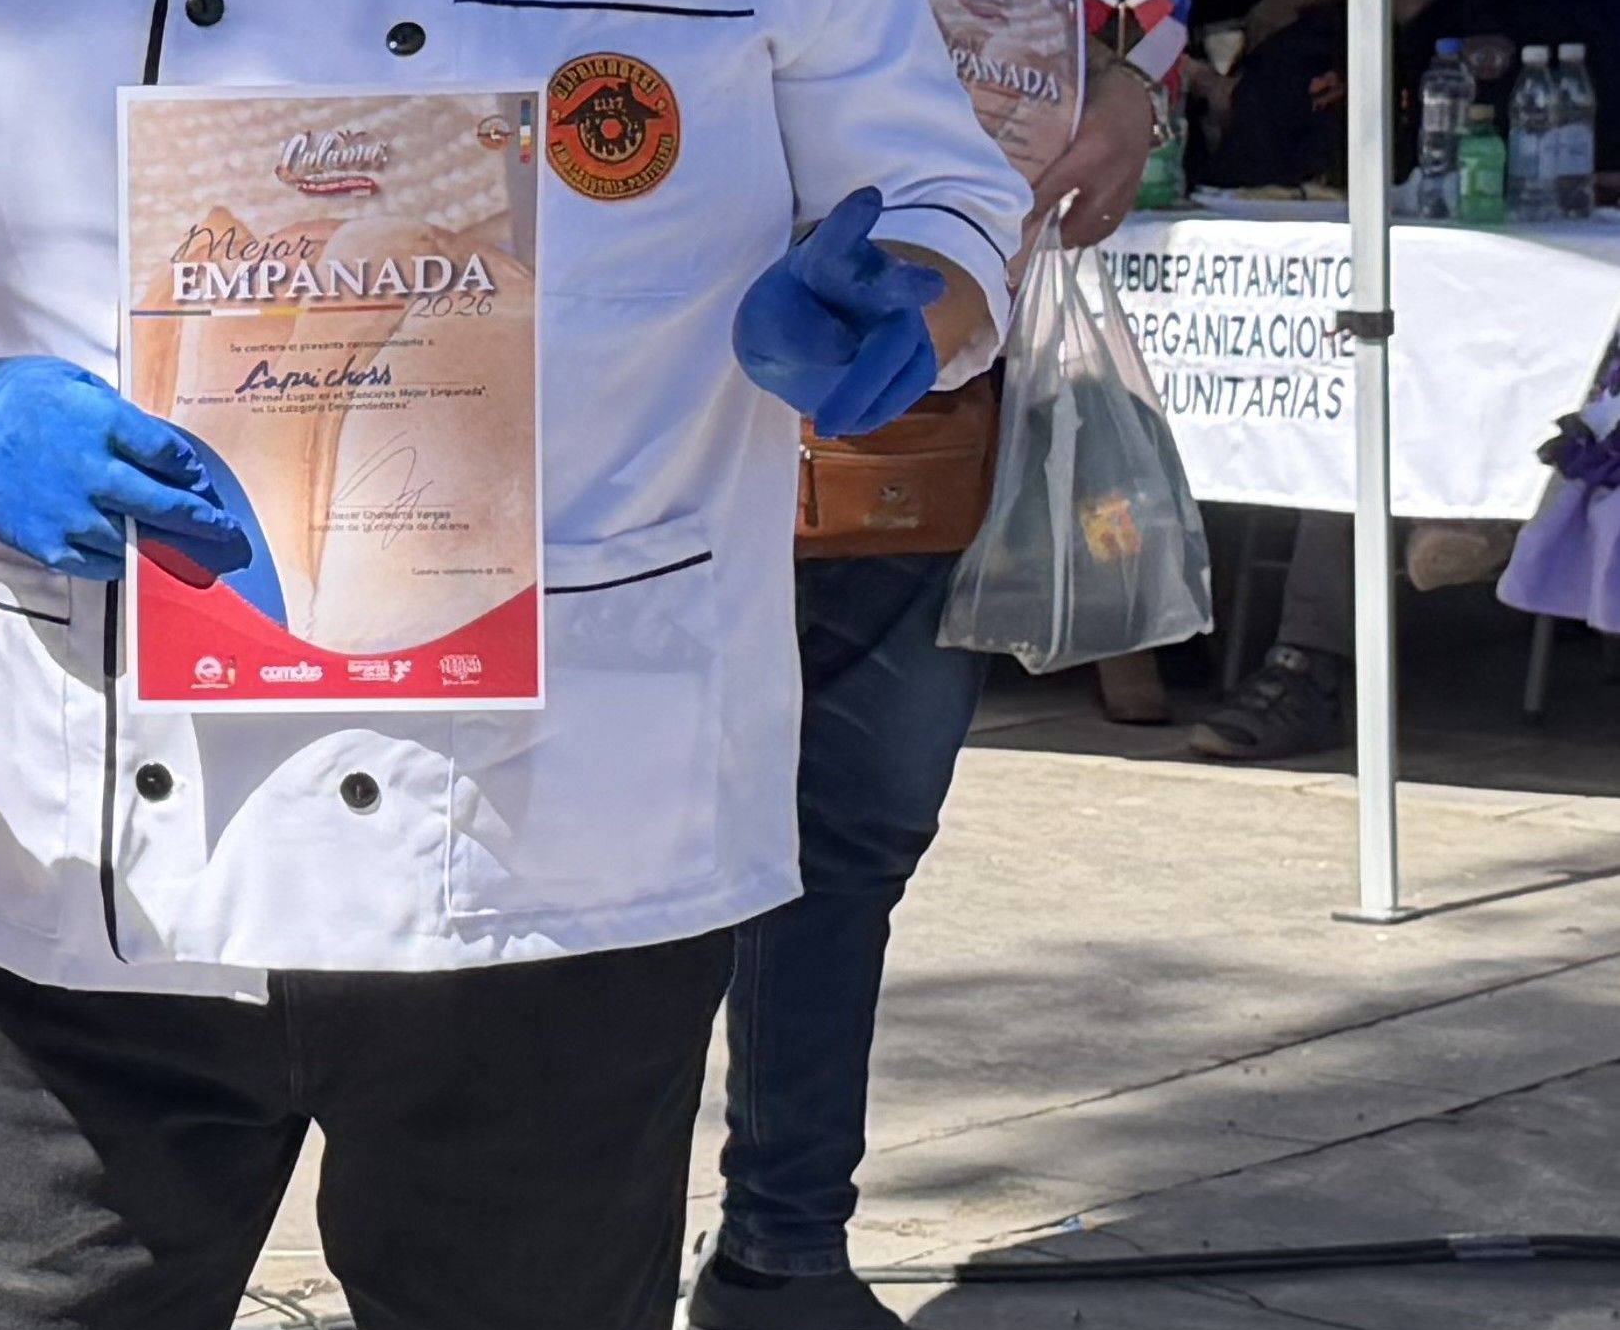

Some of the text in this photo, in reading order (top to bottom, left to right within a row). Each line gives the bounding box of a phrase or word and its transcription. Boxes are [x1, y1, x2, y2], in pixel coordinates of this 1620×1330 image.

[951, 47, 1061, 103] PANADA
[169, 223, 326, 263] Mejor
[171, 252, 495, 303] EMPANADA
[1102, 251, 1352, 299] UBDEPARTAMENTO
[409, 294, 494, 320] 2026
